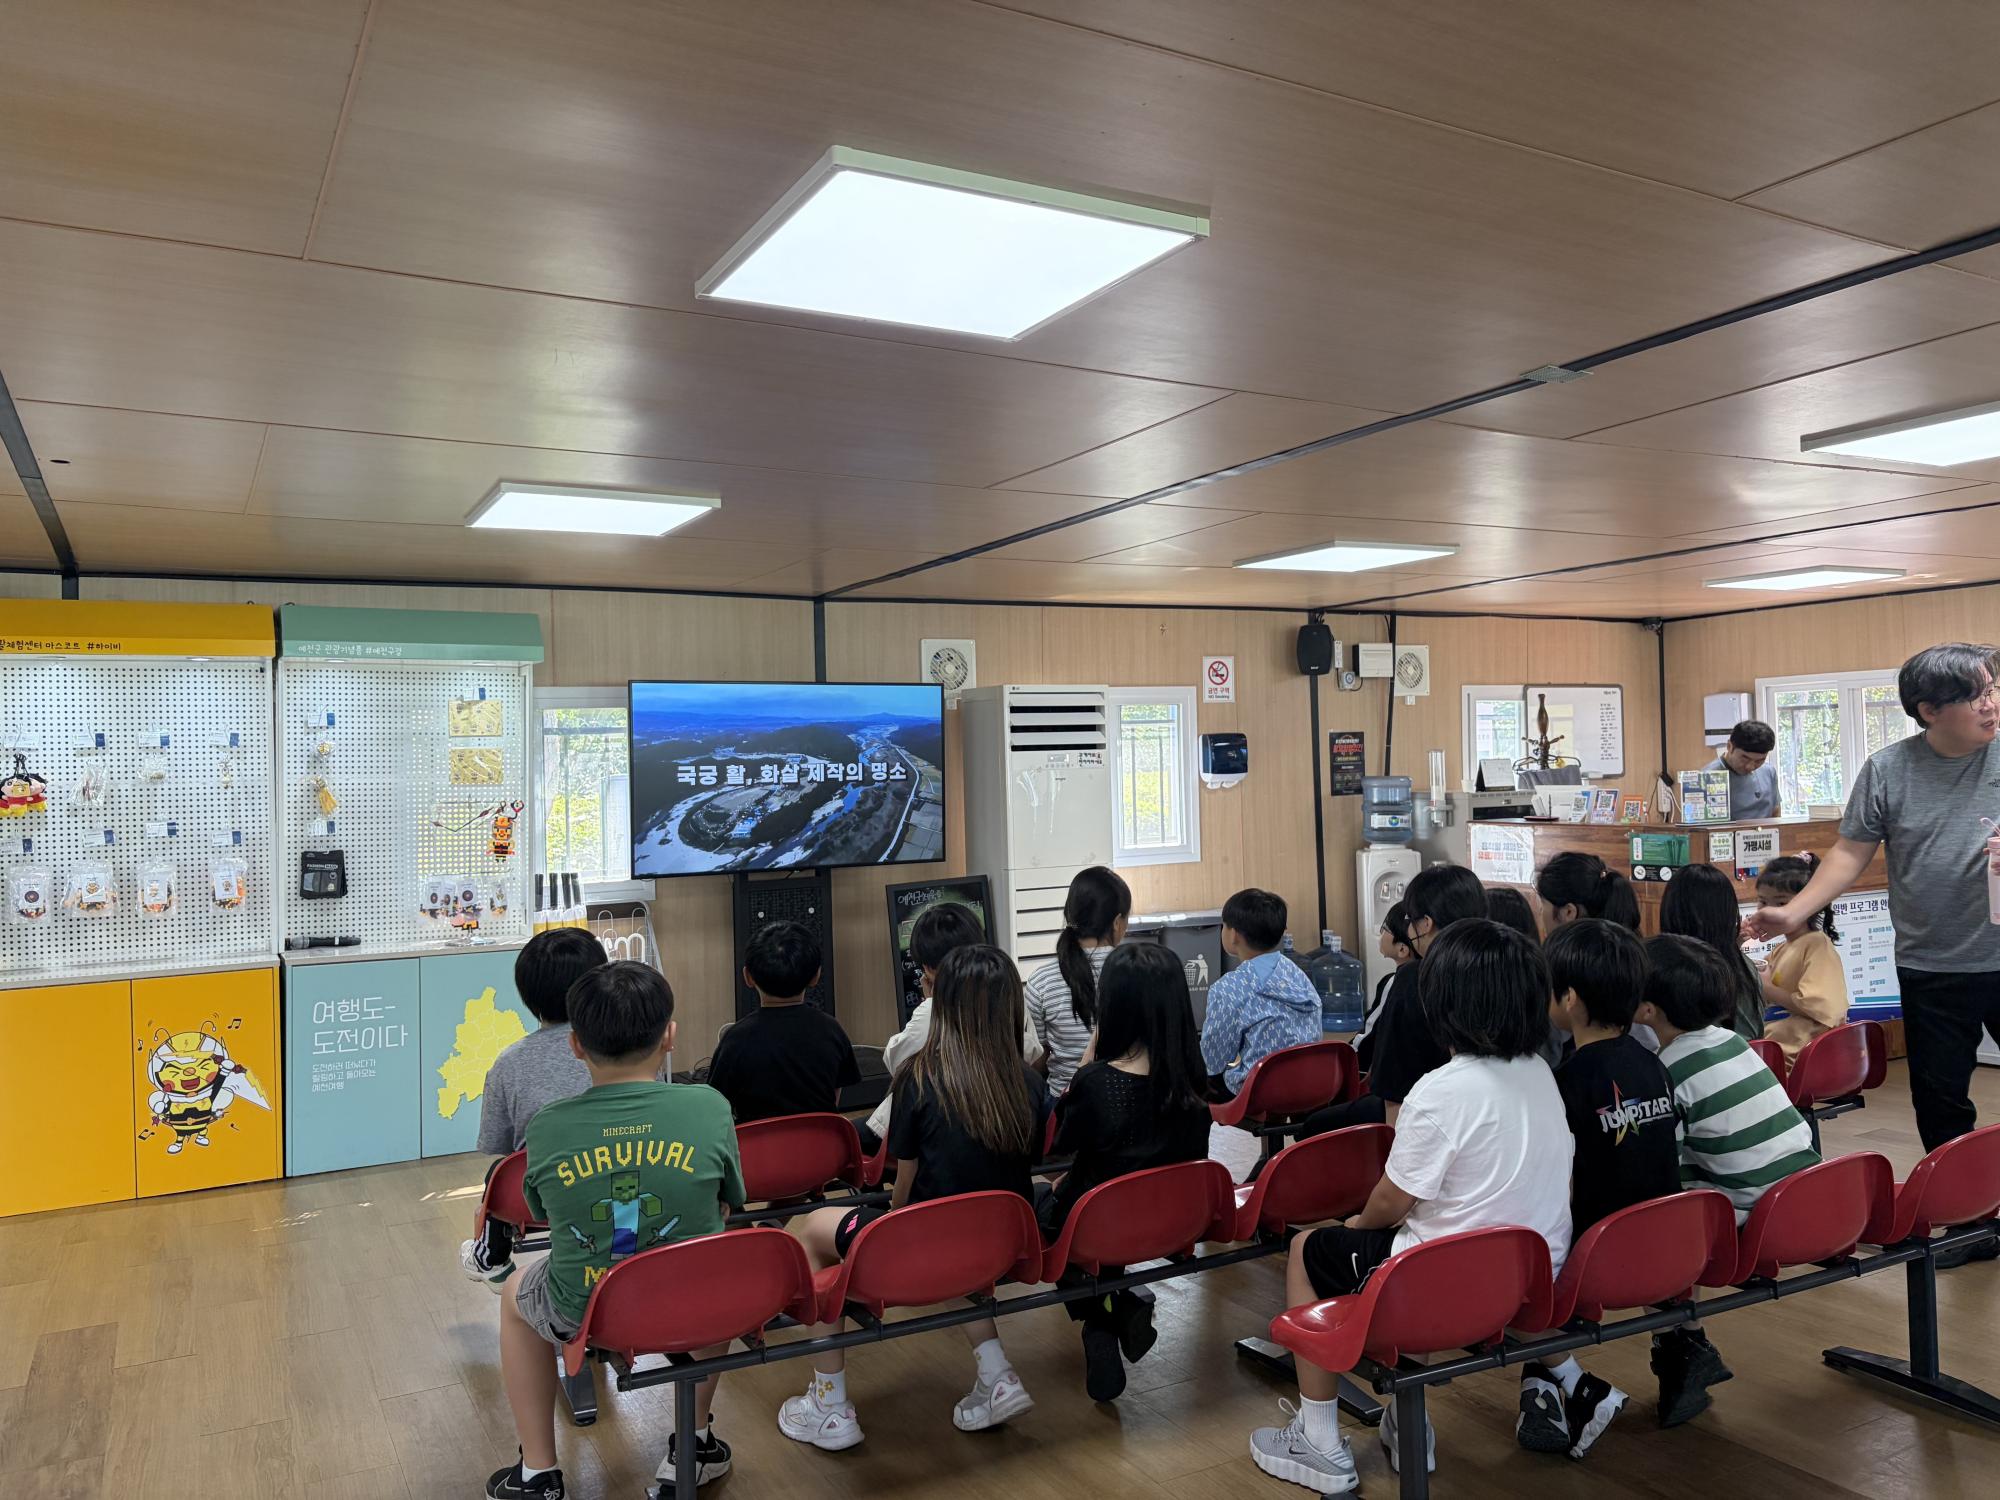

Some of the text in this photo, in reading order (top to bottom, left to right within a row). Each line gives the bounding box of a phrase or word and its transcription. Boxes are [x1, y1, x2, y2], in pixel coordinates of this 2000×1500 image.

[45, 641, 81, 650] 마스코트
[87, 642, 121, 651] #하이비
[677, 761, 907, 786] 국궁 활, 화살 제작의 명소
[1832, 899, 1888, 916] 일반 프로그램 안
[312, 1024, 409, 1055] 도전이다
[312, 1061, 344, 1073] 도전하러
[312, 1081, 344, 1093] 예천여행
[1599, 1097, 1672, 1133] JUMPSTAR
[603, 1124, 653, 1137] MINECRAFT
[557, 1140, 695, 1187] SURVIVAL
